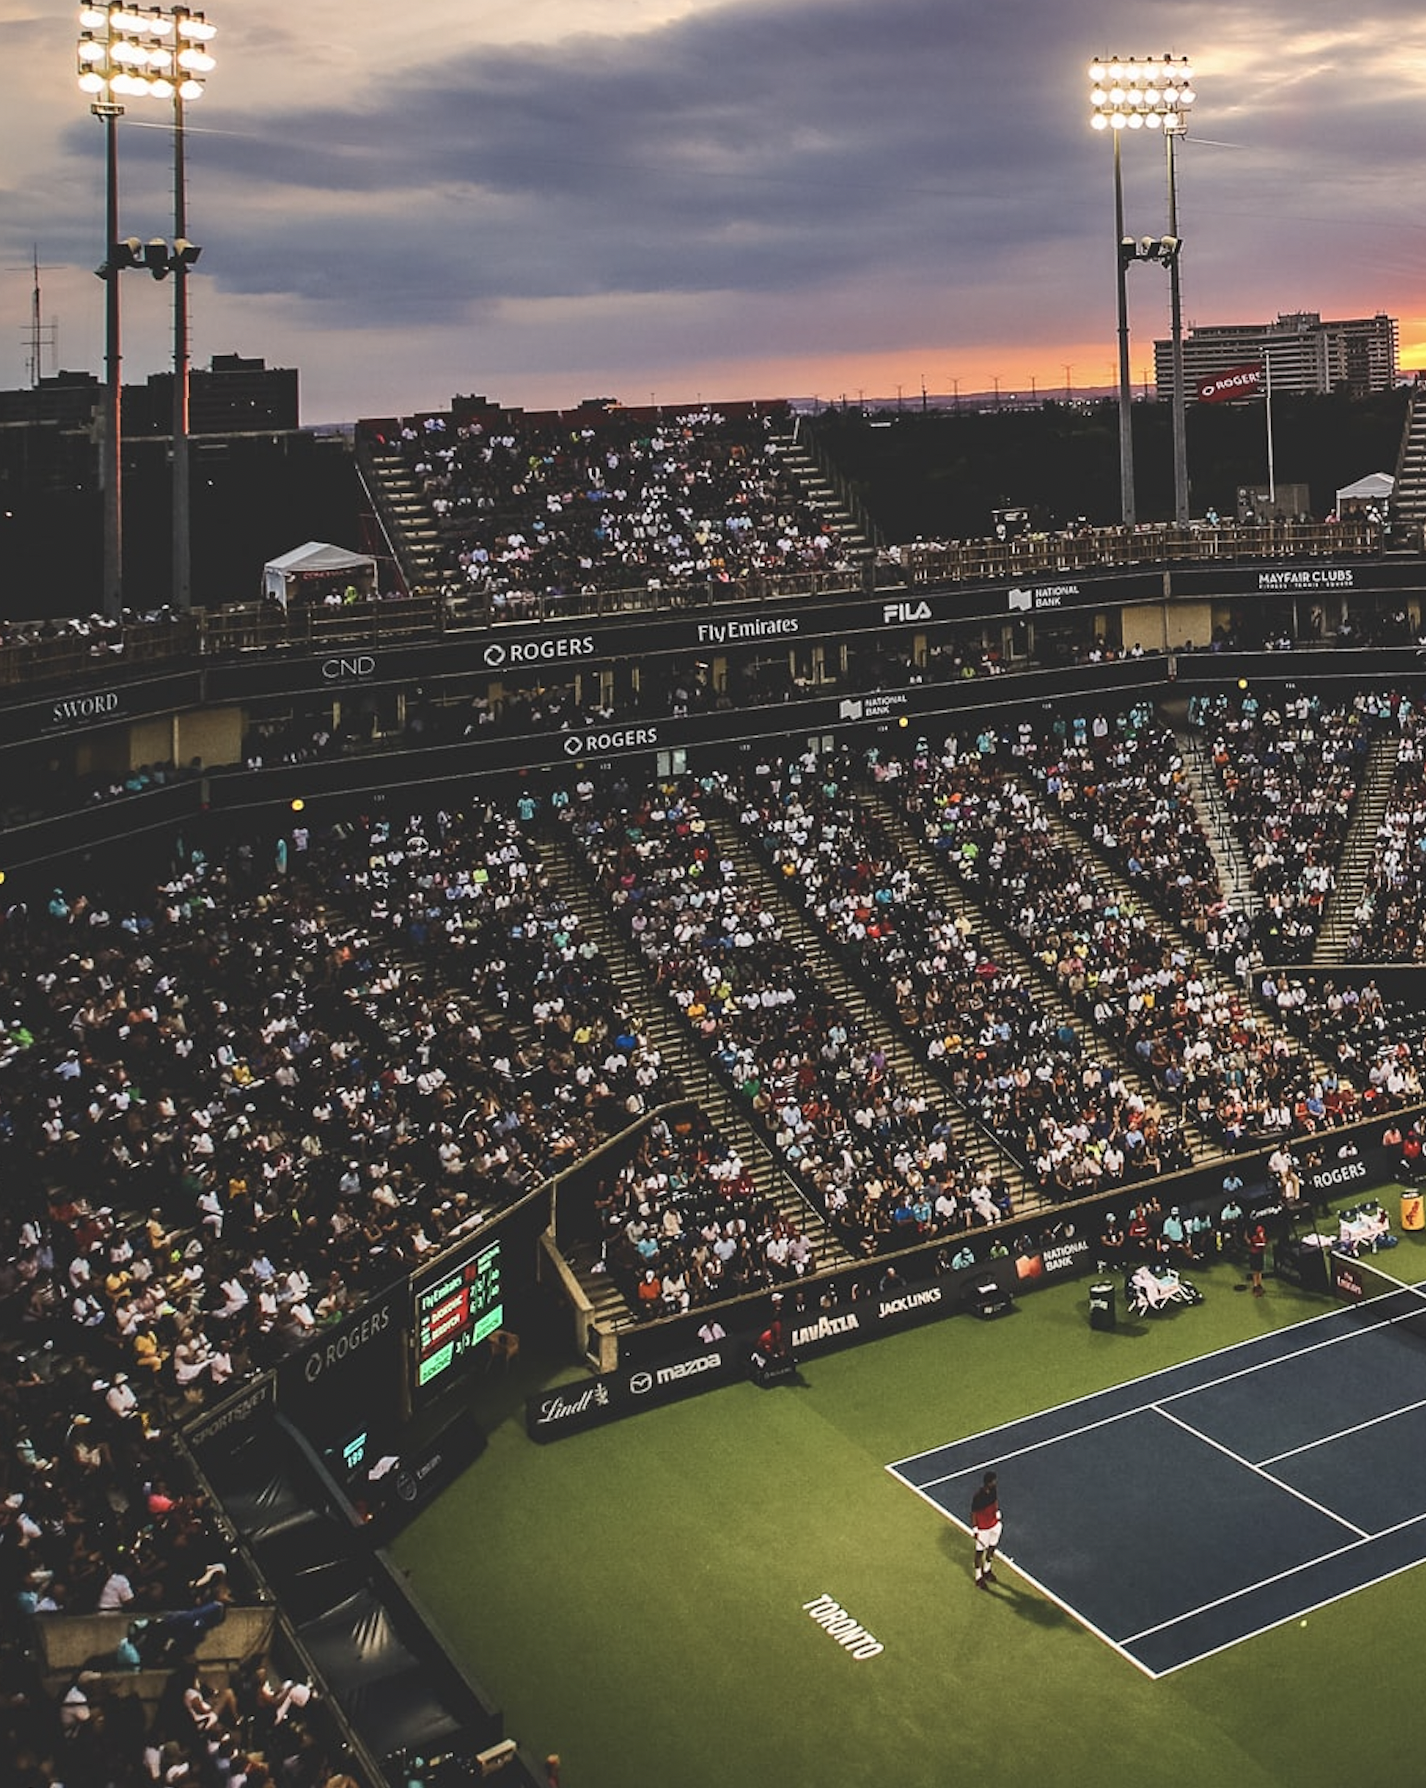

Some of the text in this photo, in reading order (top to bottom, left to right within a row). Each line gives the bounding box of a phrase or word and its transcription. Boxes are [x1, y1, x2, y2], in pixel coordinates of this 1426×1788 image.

[1258, 569, 1354, 584] MAYFAIR CLUBS
[1035, 585, 1080, 600] NATIONAL
[1035, 597, 1062, 608] BANK
[883, 601, 932, 624] FILA
[698, 618, 799, 643] Fly Emirates
[510, 636, 595, 663] ROGERS
[321, 656, 376, 679] CND
[53, 692, 119, 722] SWORD
[864, 693, 908, 708] NATIONAL
[864, 704, 891, 718] BANK
[586, 727, 658, 752] ROGERS
[1313, 1161, 1367, 1189] ROGERS
[1043, 1240, 1090, 1262] NATIONAL
[1044, 1254, 1074, 1272] BANK
[878, 1299, 908, 1319] JACK
[326, 1305, 390, 1367] ROGERS
[791, 1313, 860, 1347] LAVAZZA
[656, 1352, 722, 1385] mazda
[536, 1389, 594, 1424] Lindt
[801, 1592, 885, 1660] TORONTO
